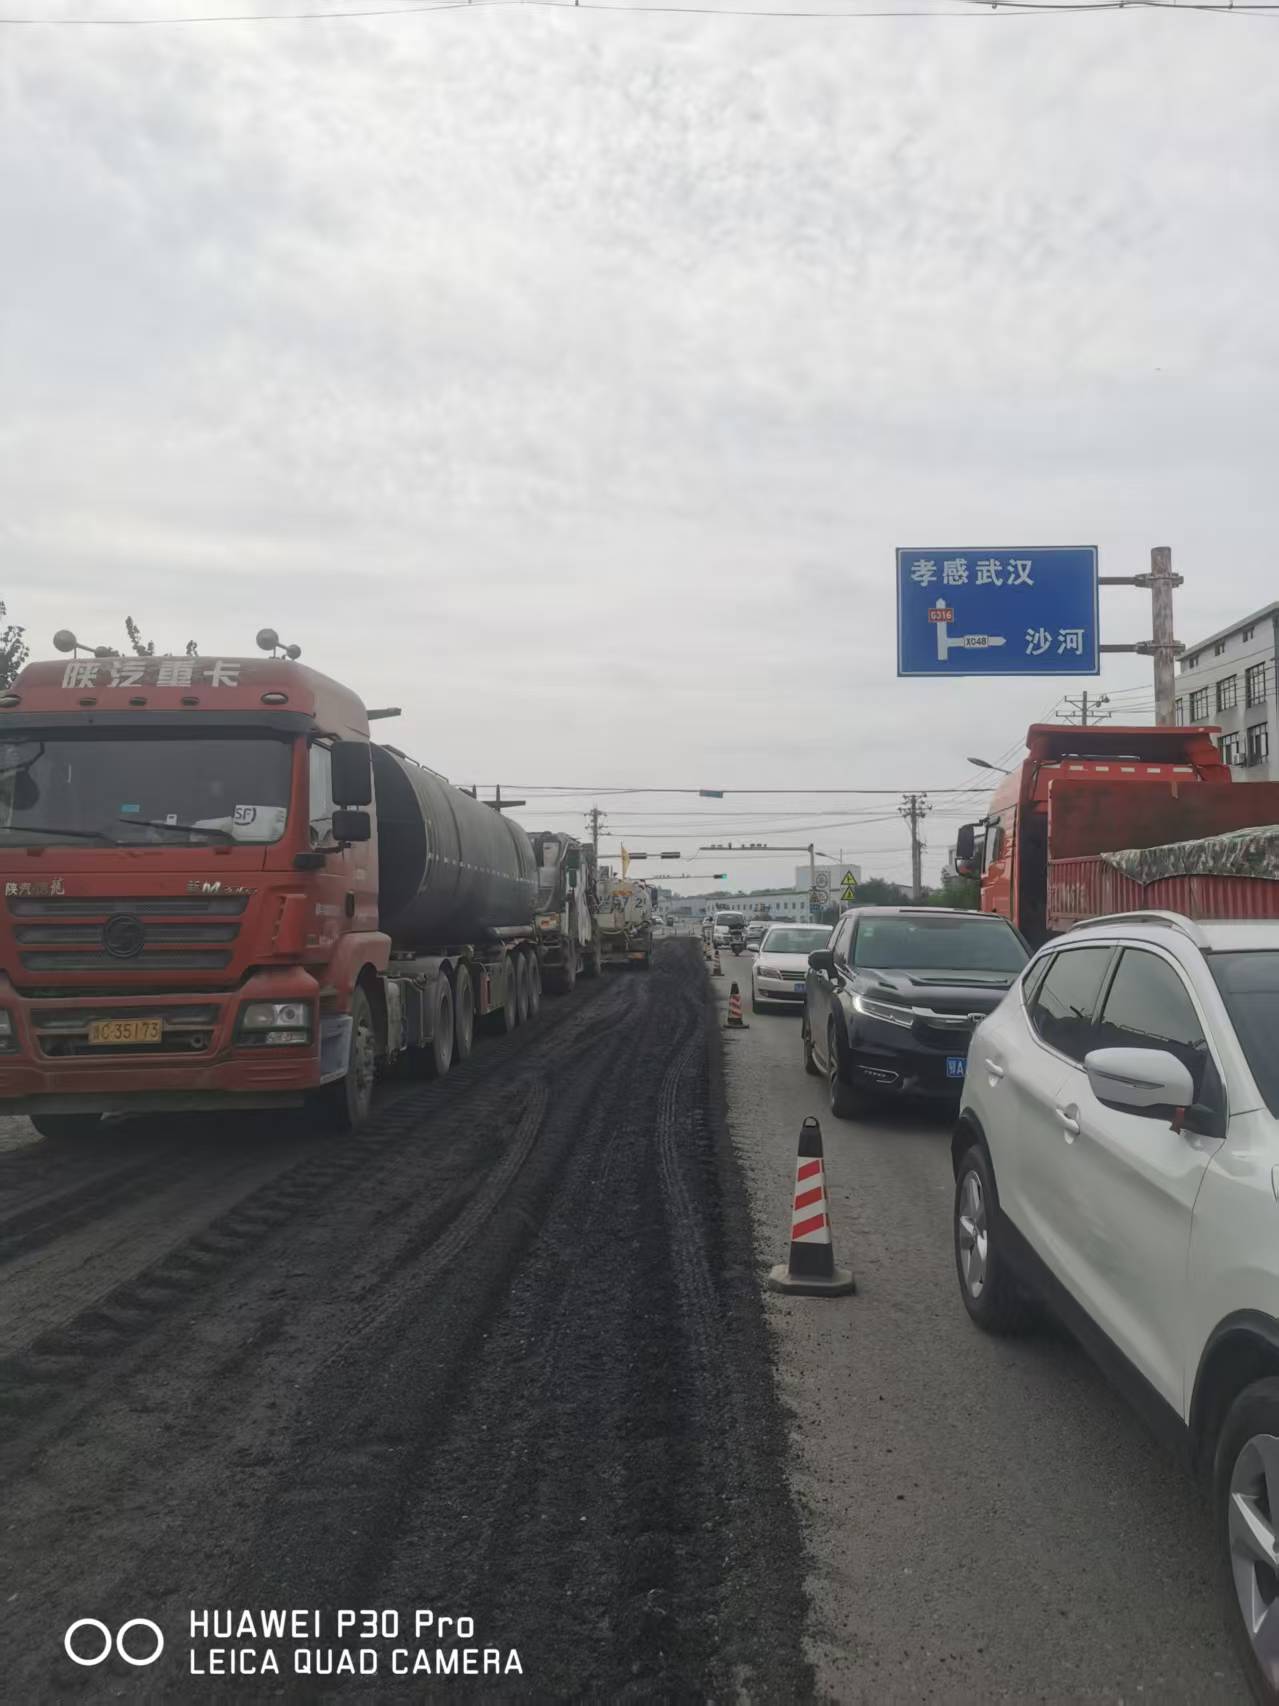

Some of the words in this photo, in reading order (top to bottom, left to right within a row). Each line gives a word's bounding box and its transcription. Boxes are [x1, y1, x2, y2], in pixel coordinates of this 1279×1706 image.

[911, 559, 1034, 586] 孝感武汉
[930, 610, 952, 620] G316
[966, 637, 987, 646] X048
[1025, 628, 1085, 655] 沙河
[62, 660, 240, 688] 陕汽重卡
